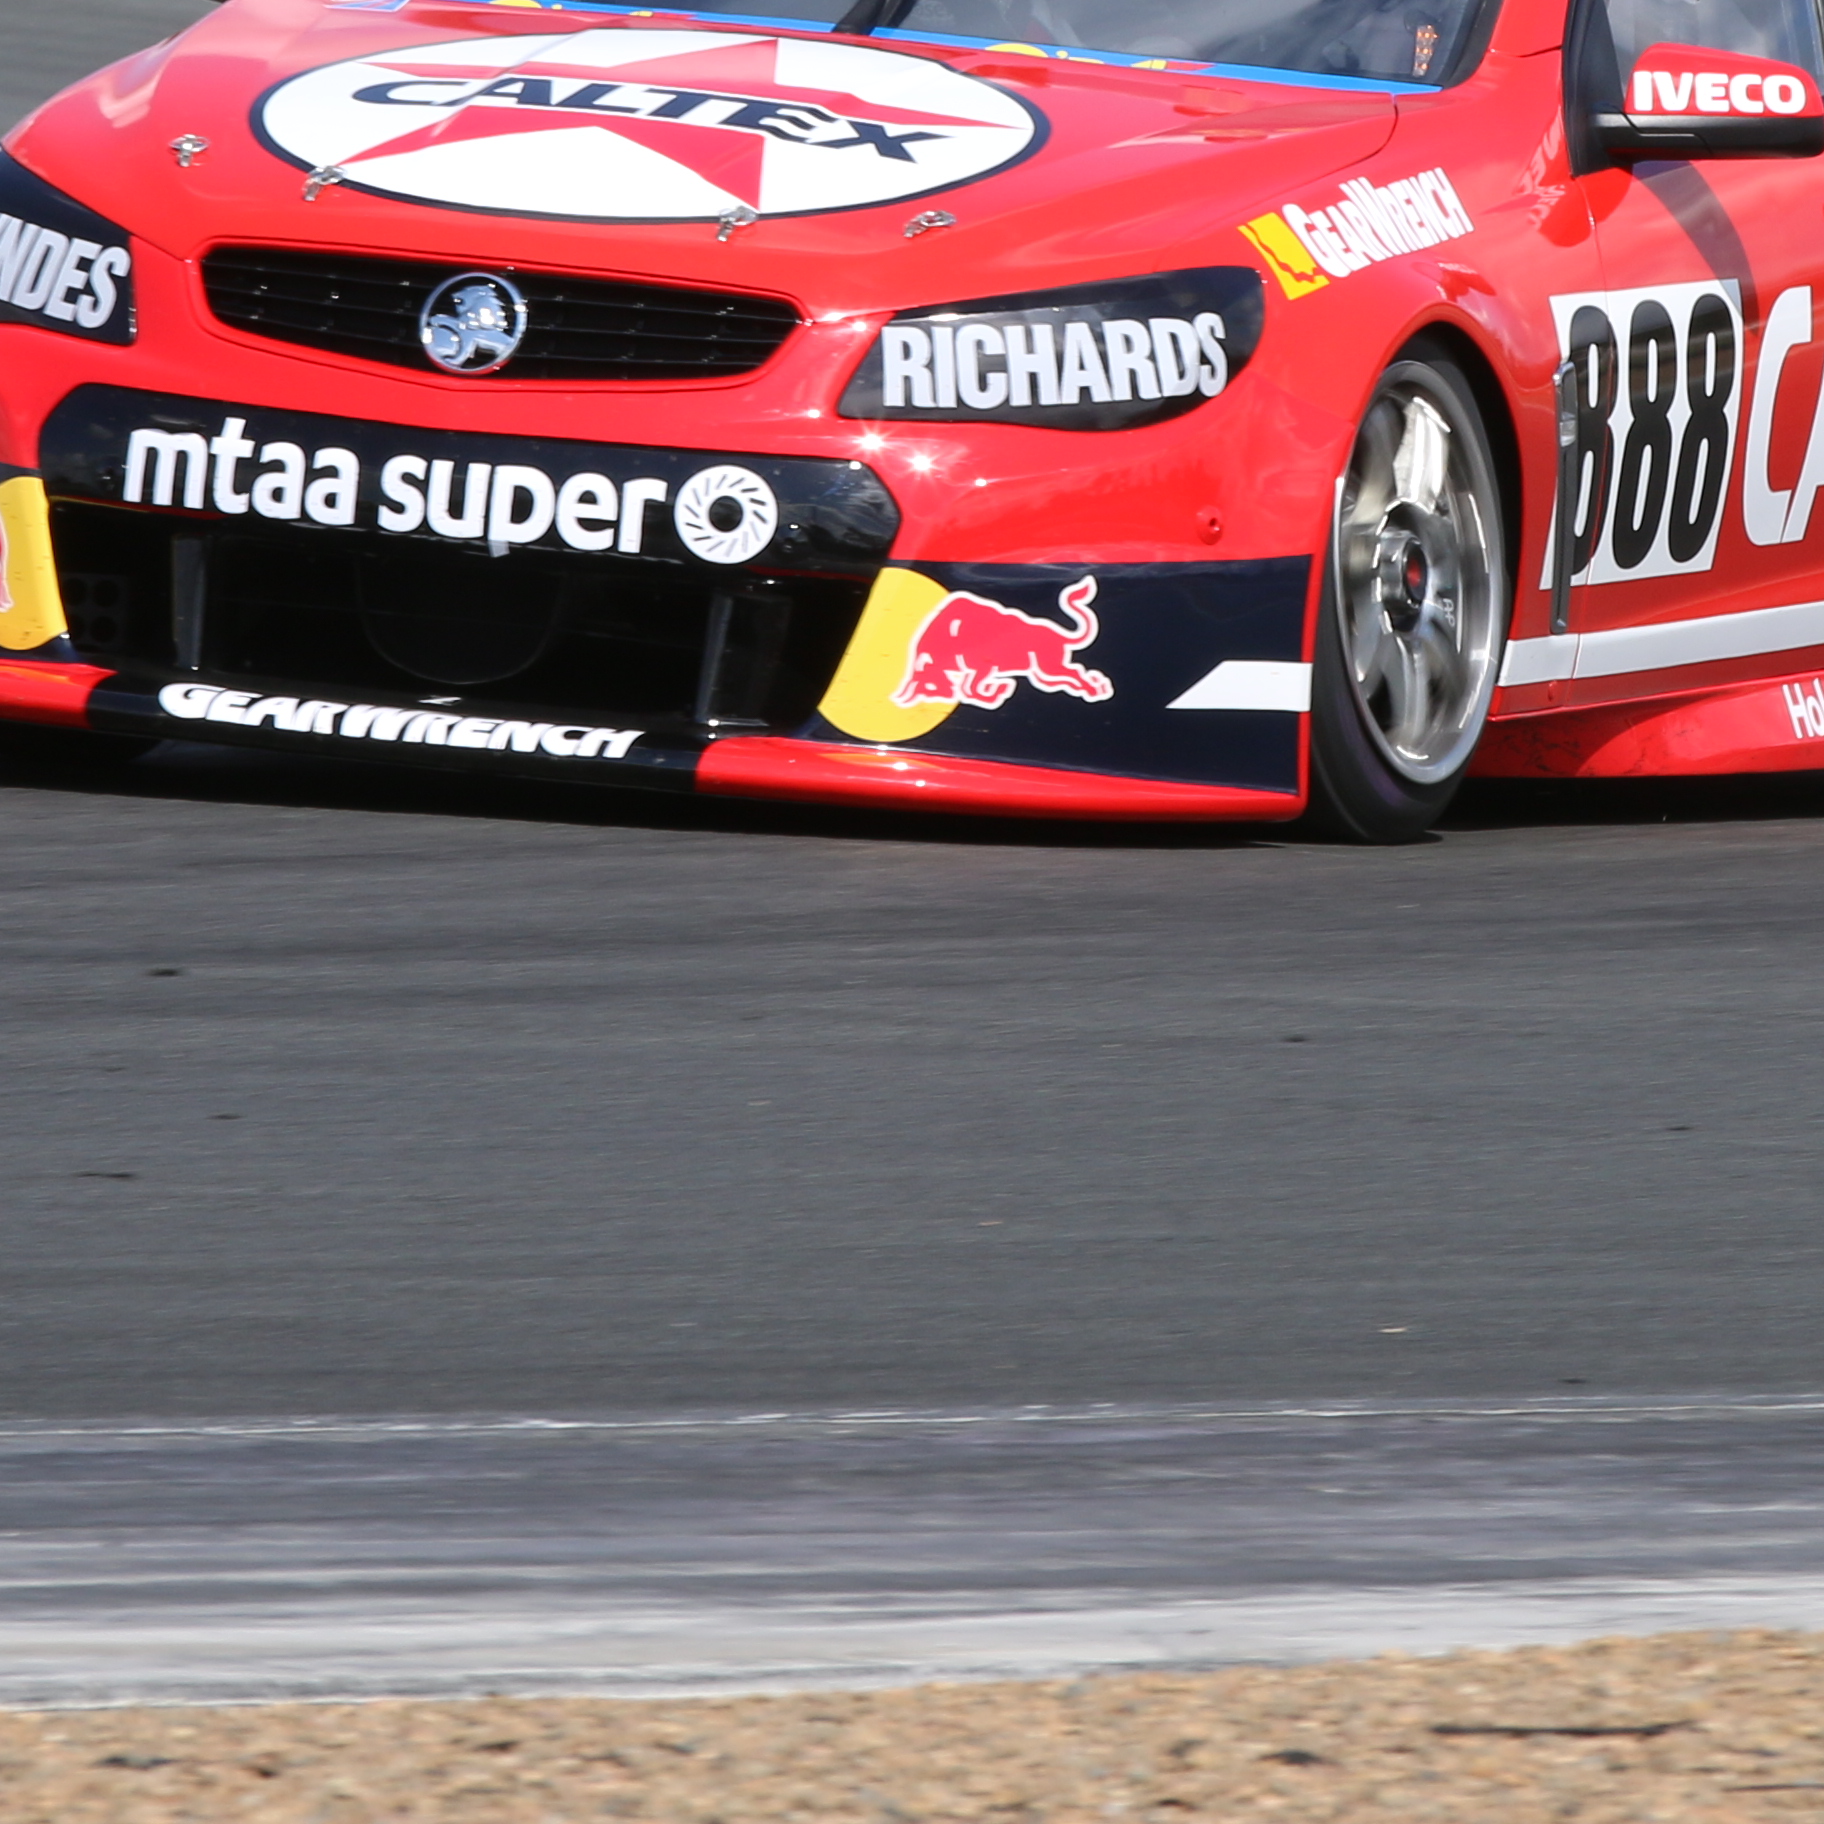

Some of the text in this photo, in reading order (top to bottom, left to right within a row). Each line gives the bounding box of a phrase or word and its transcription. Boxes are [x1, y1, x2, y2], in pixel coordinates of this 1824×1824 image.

[352, 77, 952, 164] CALTEX
[1633, 71, 1806, 115] IVECO
[882, 312, 1229, 409] RICHARDS
[1569, 293, 1735, 576] 888
[123, 417, 668, 558] mtaa super
[158, 682, 646, 759] GEARWRENCH
